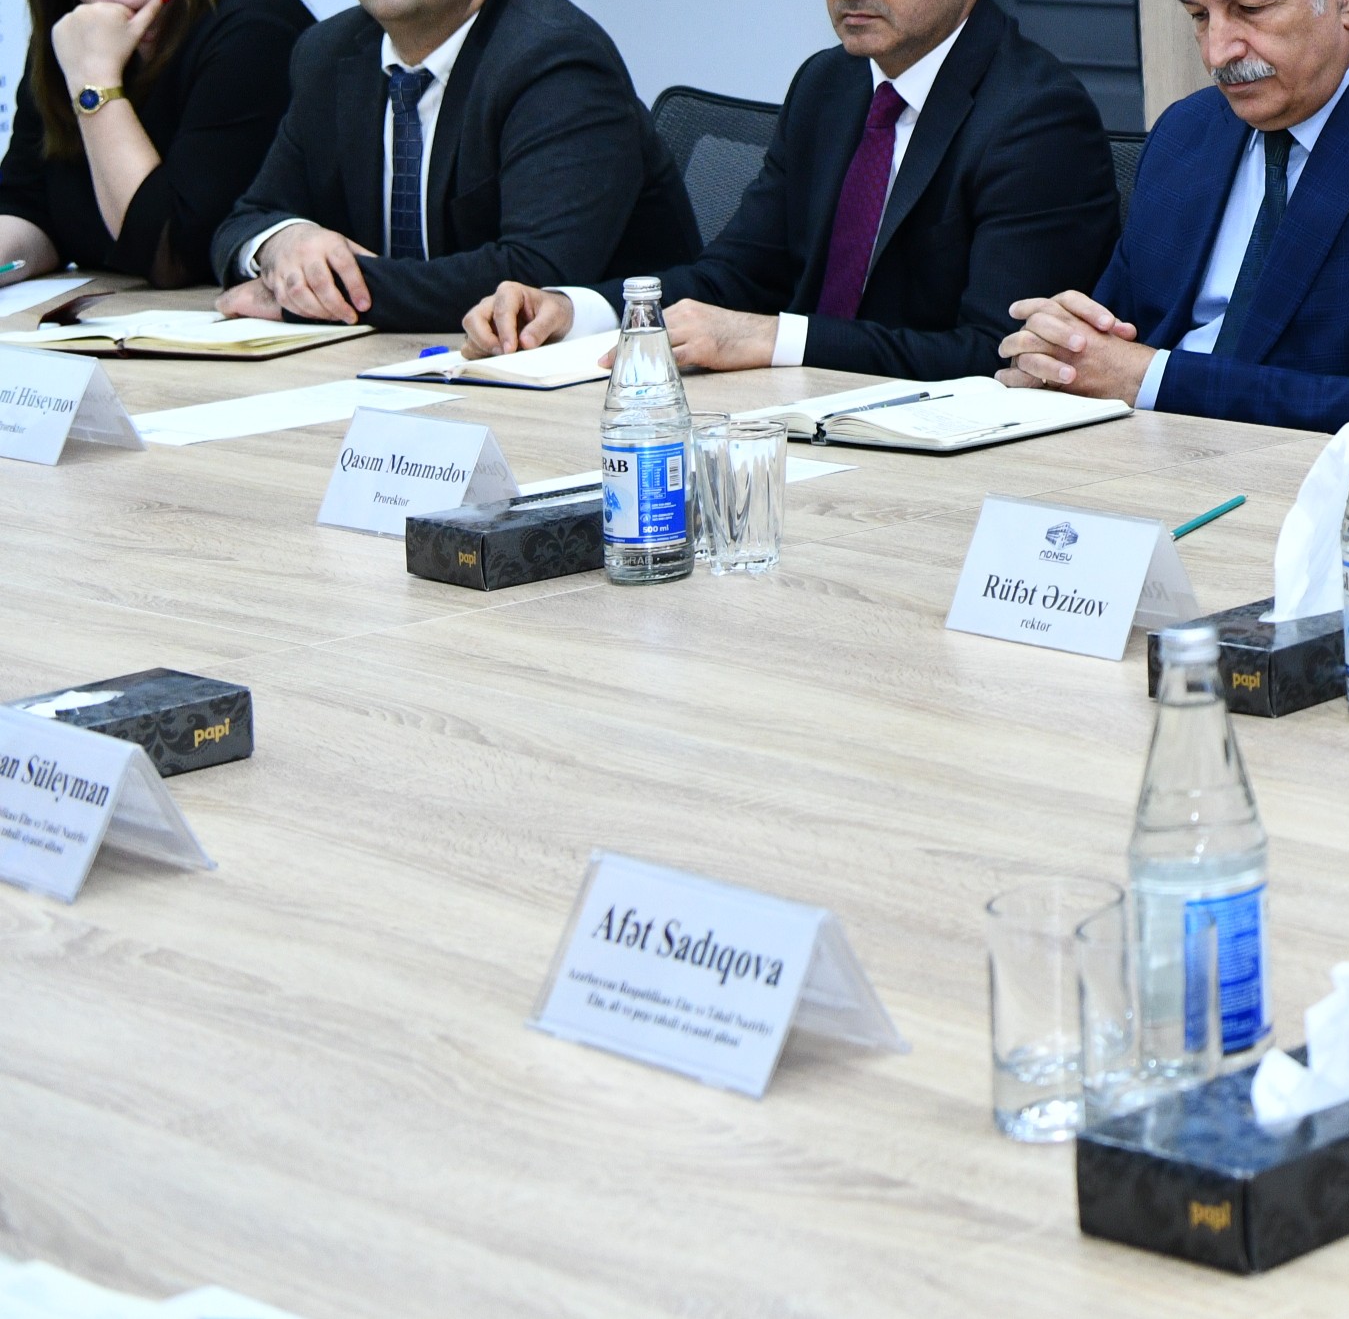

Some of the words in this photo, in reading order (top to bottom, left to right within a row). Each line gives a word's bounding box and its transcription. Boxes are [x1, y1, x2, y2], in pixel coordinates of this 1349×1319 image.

[16, 387, 77, 415] Hüseynov
[340, 447, 384, 472] Qasım
[385, 453, 472, 483] Məmmədov
[373, 491, 411, 507] Prorektor
[642, 525, 659, 534] 500
[660, 524, 669, 532] ml
[458, 550, 477, 568] papi
[982, 574, 1037, 606] Rüfət
[1042, 585, 1109, 618] Əzizov
[1020, 617, 1052, 633] rektor
[1232, 670, 1261, 692] papi
[193, 717, 230, 748] papi
[21, 754, 110, 808] Süleyman
[592, 904, 656, 951] Afət
[656, 918, 784, 986] Sadıqova
